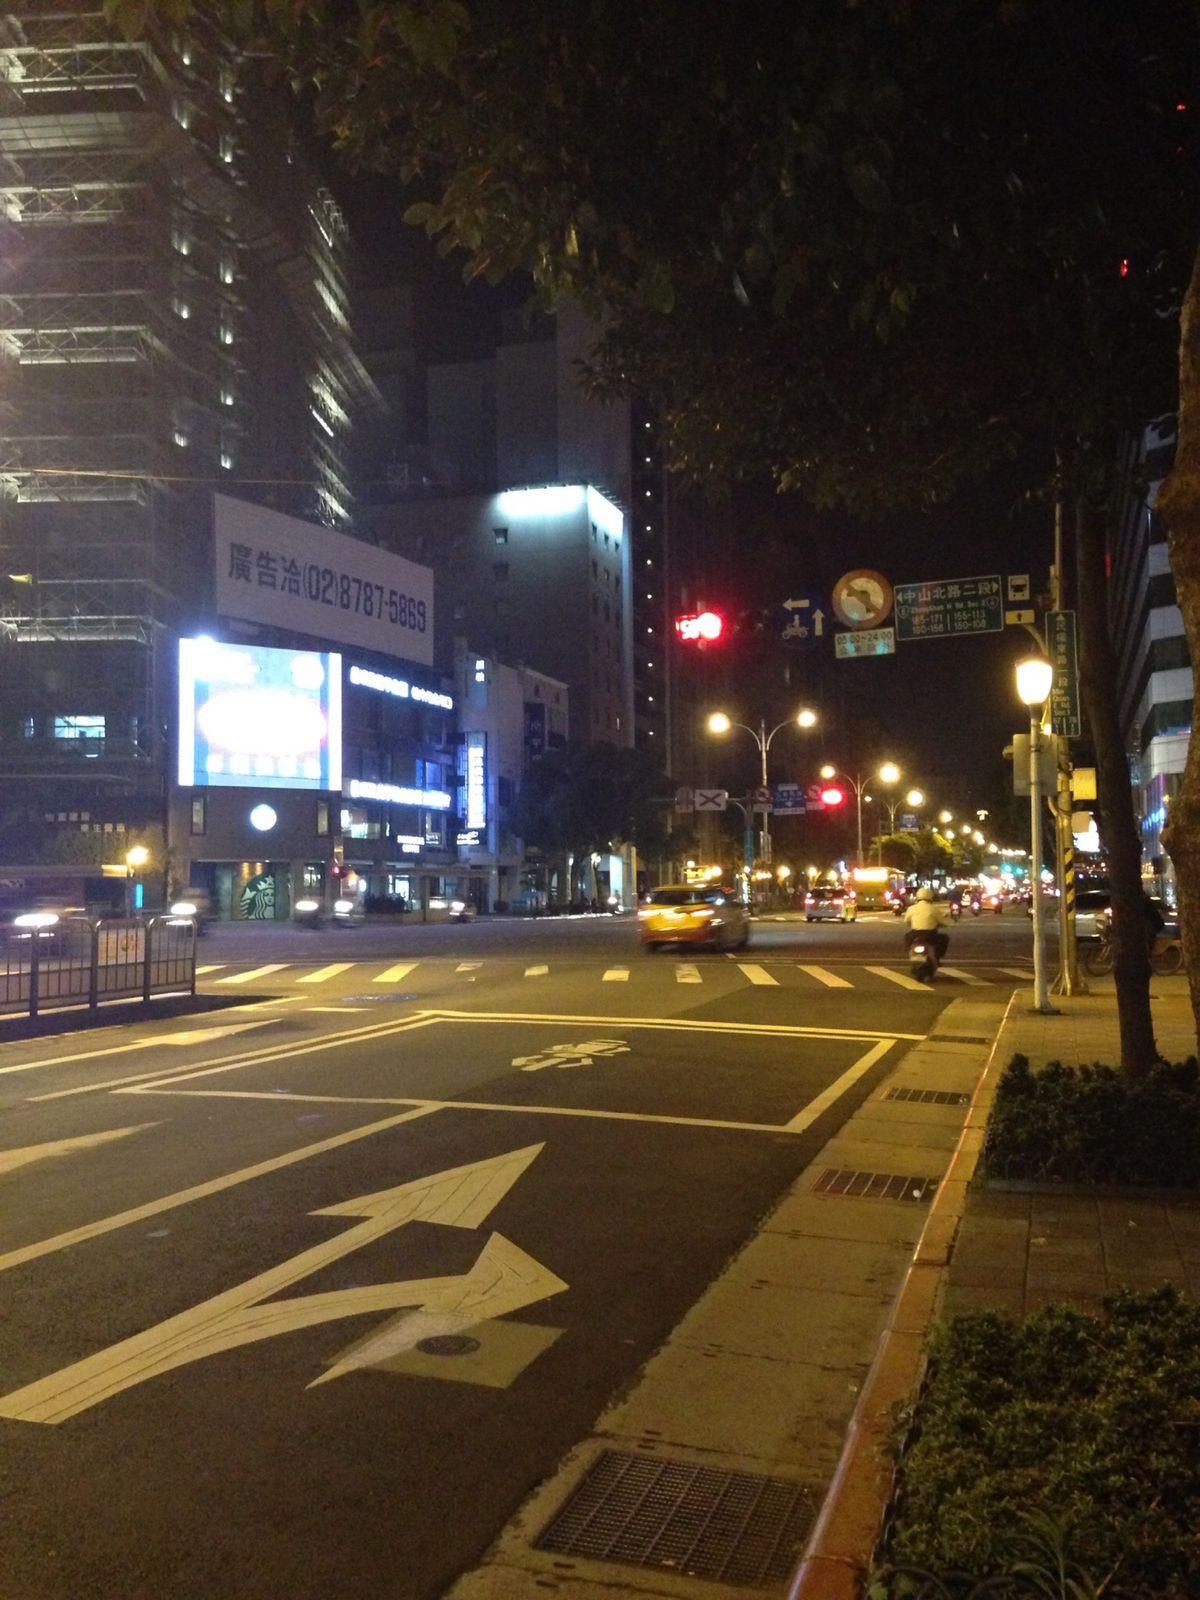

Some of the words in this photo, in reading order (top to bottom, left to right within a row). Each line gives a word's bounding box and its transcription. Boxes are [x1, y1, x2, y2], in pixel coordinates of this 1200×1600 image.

[904, 581, 991, 603] 中山北路二段
